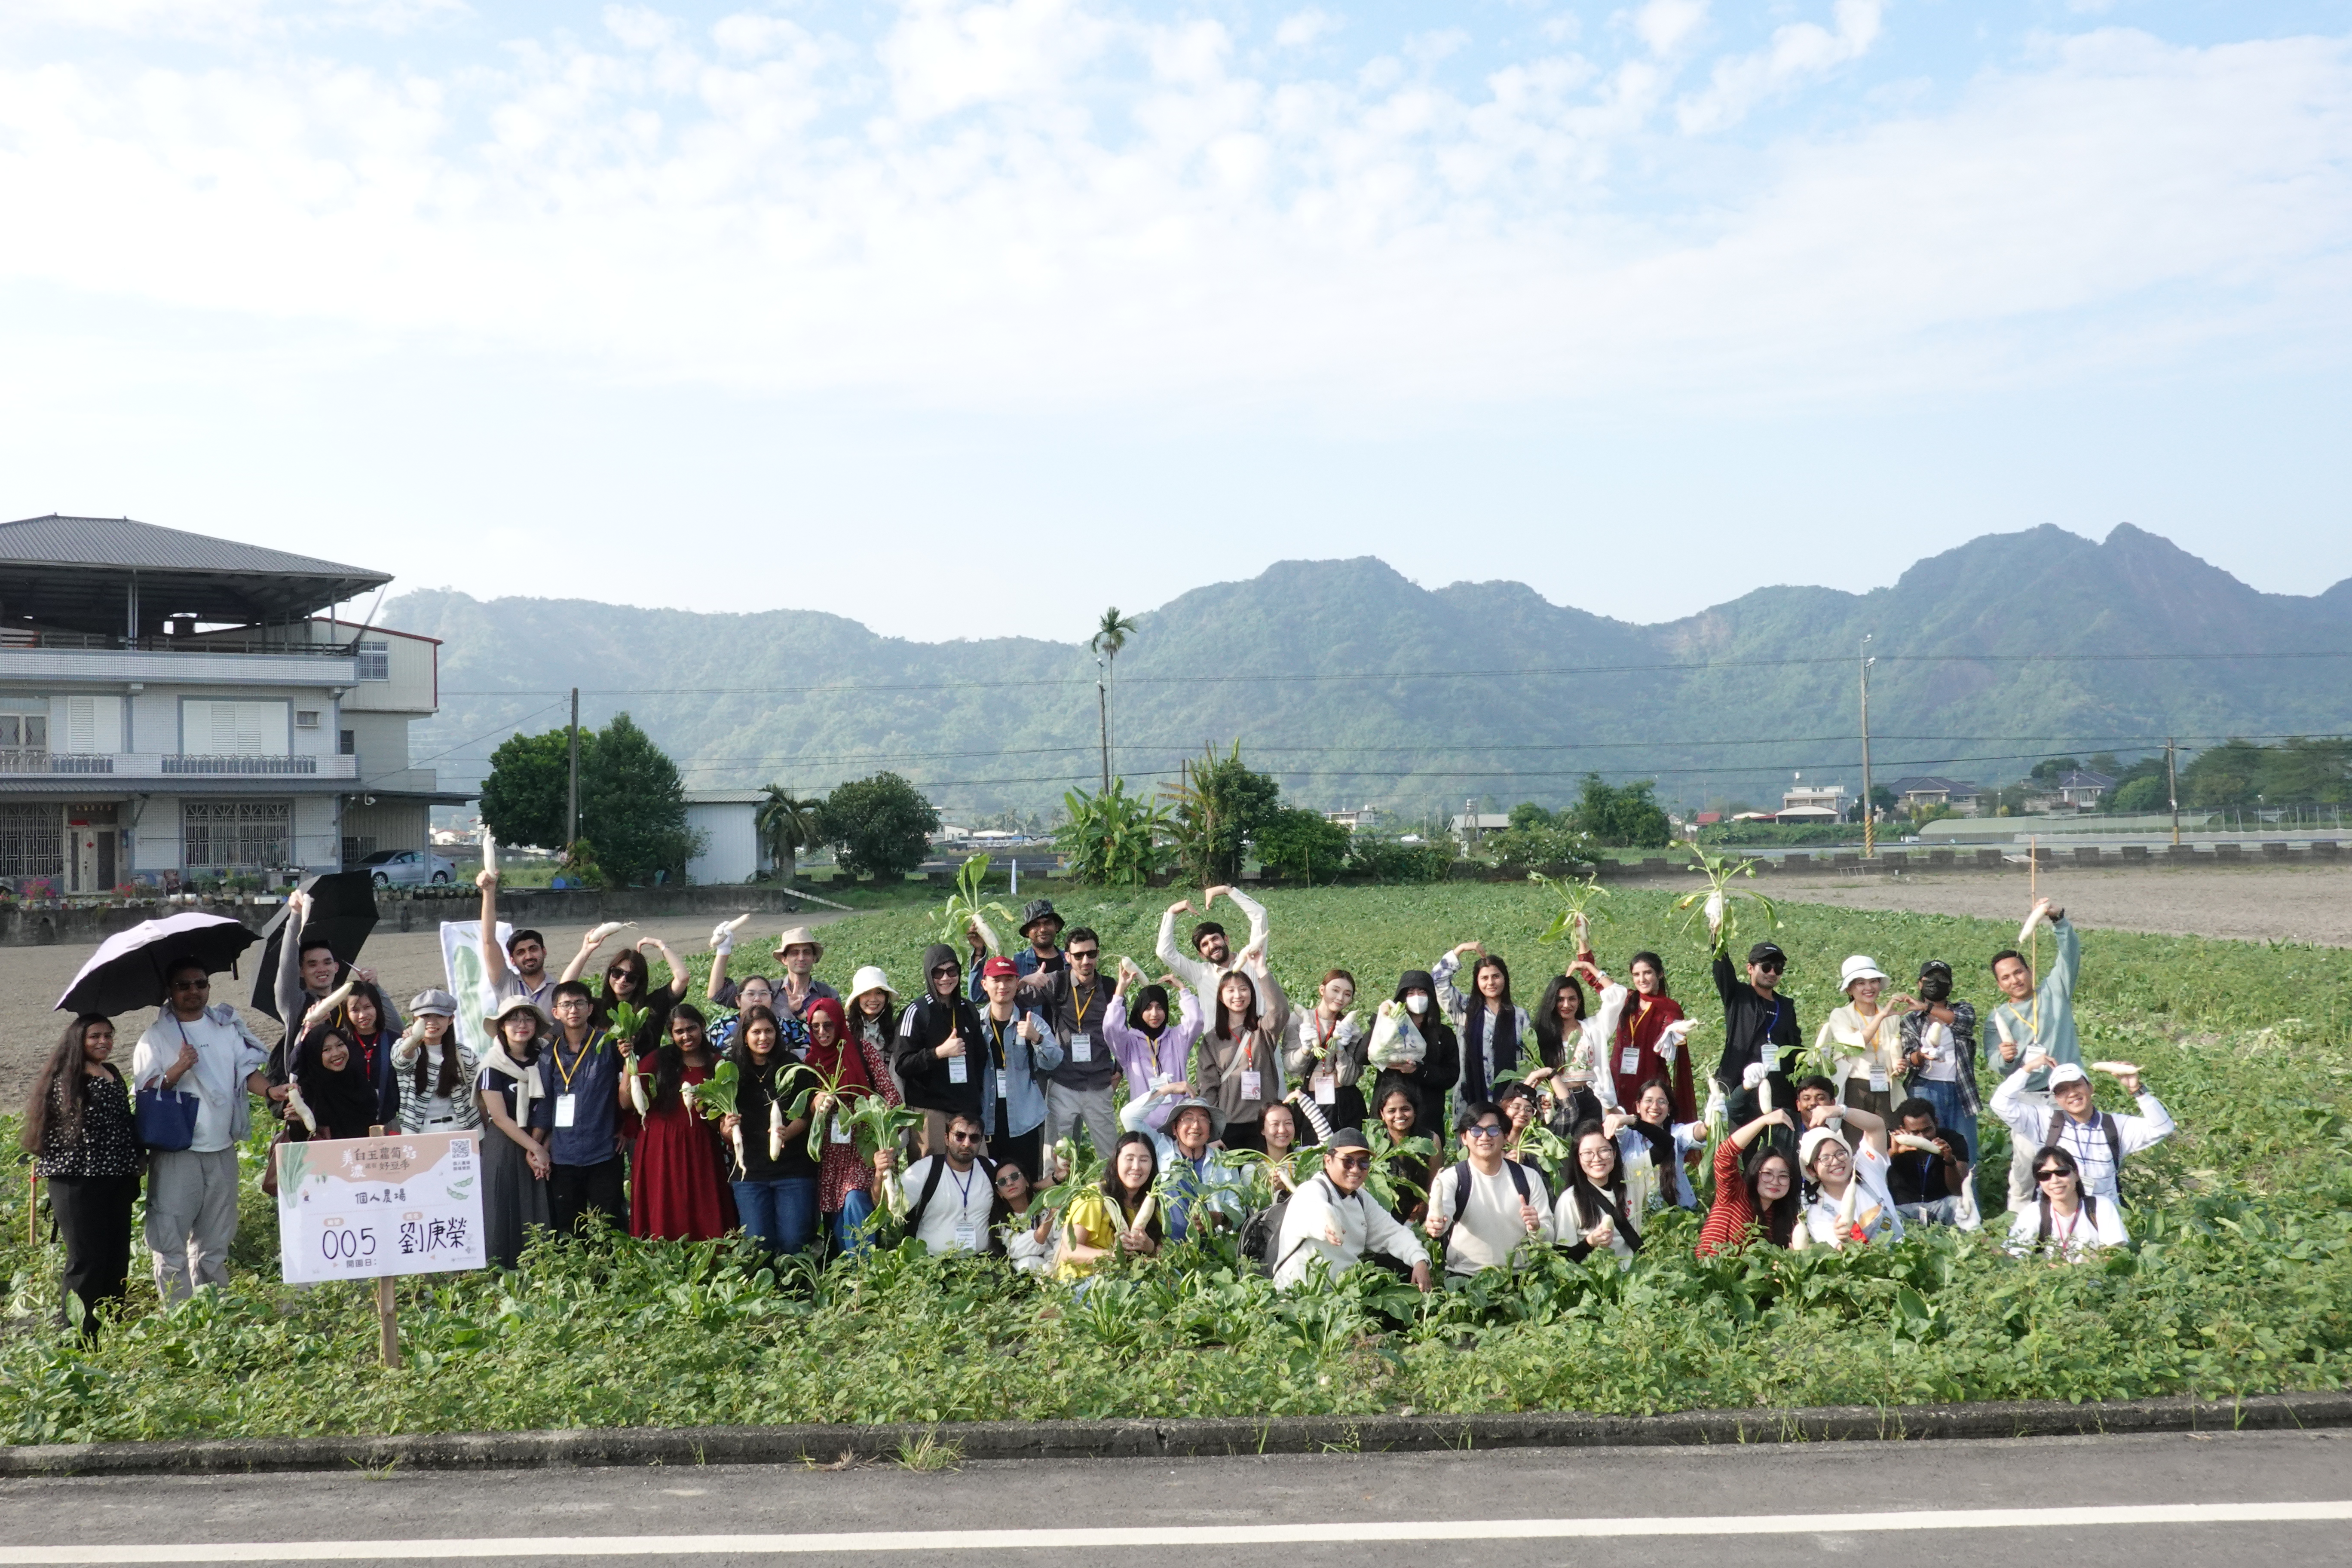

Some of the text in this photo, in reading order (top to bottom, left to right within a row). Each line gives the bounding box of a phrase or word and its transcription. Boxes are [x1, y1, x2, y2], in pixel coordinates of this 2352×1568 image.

[355, 1188, 406, 1204] 個人農場
[322, 1228, 376, 1260] 005
[398, 1217, 467, 1254] 劉庚榮
